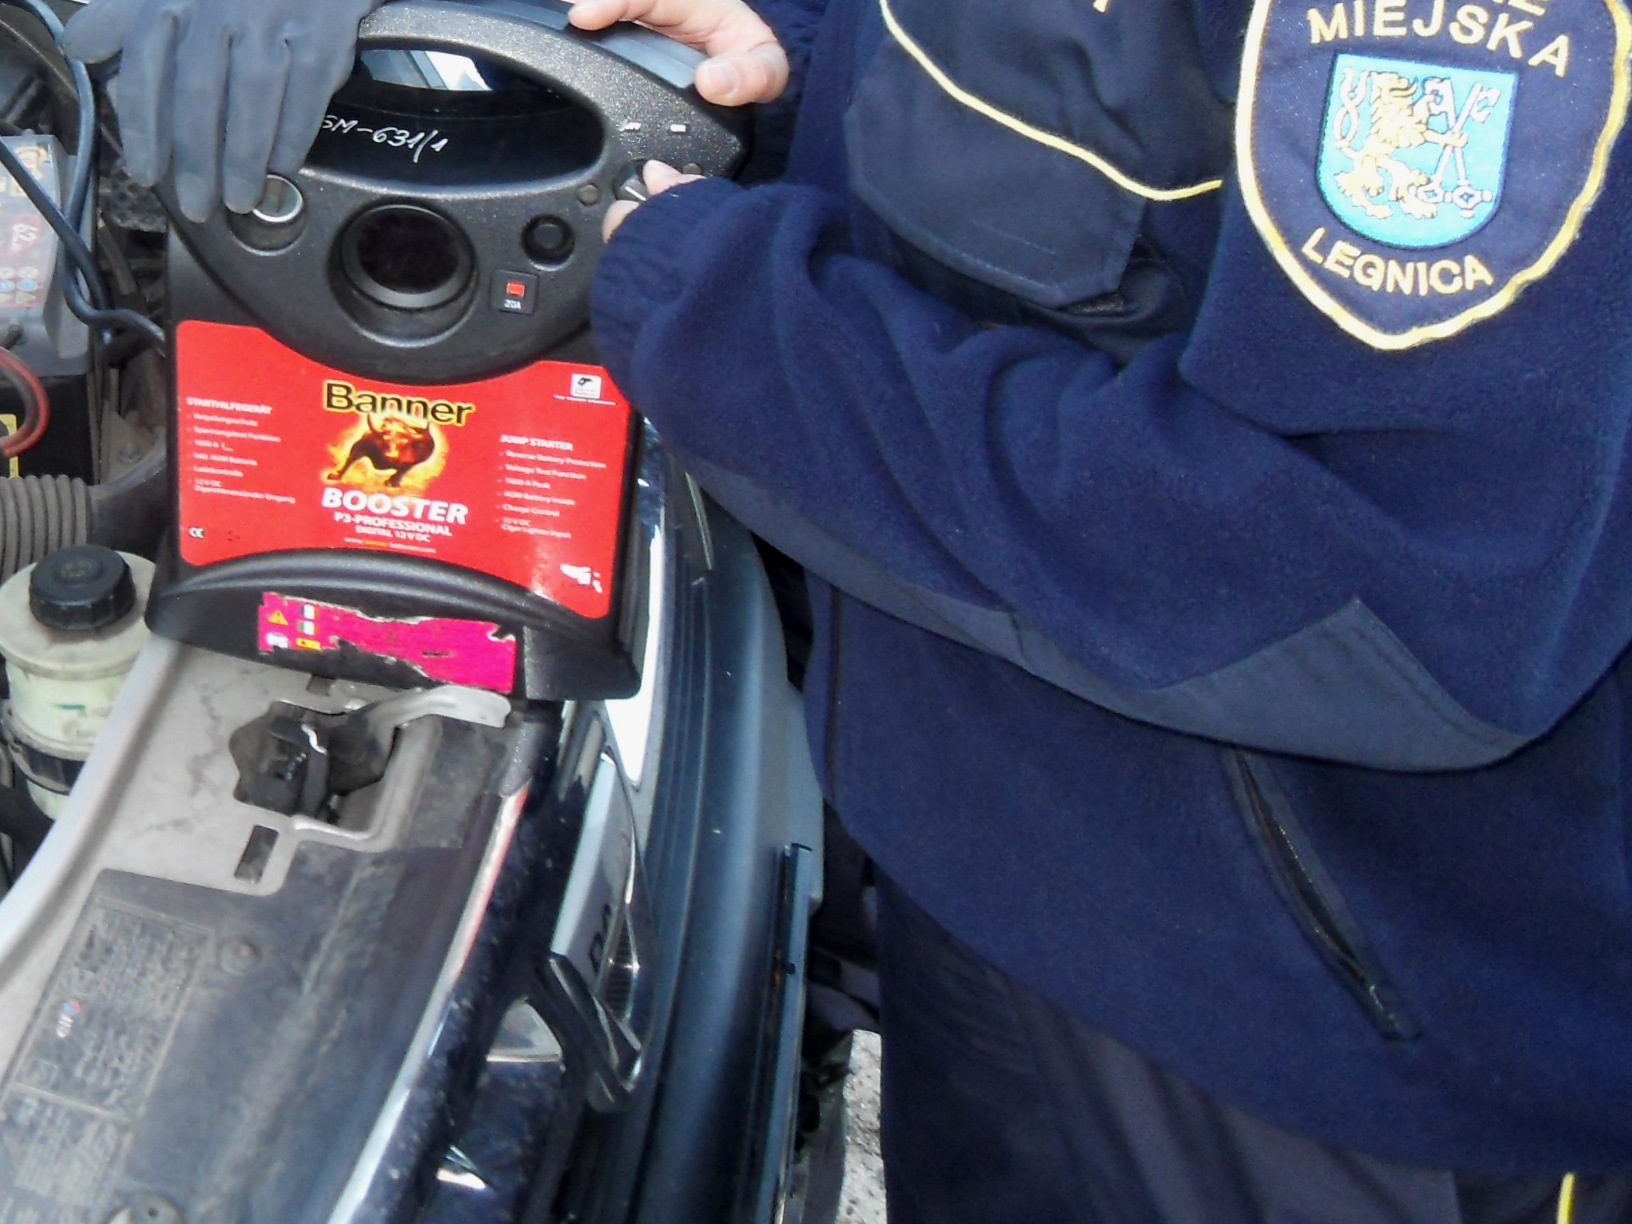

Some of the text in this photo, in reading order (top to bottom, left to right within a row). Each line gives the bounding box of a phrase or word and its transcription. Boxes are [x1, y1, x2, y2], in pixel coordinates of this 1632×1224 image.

[1301, 226, 1495, 296] LEGNICA
[325, 381, 474, 425] Banner
[321, 487, 469, 525] BOOSTER
[333, 512, 453, 536] P3-PROFESSIONAL
